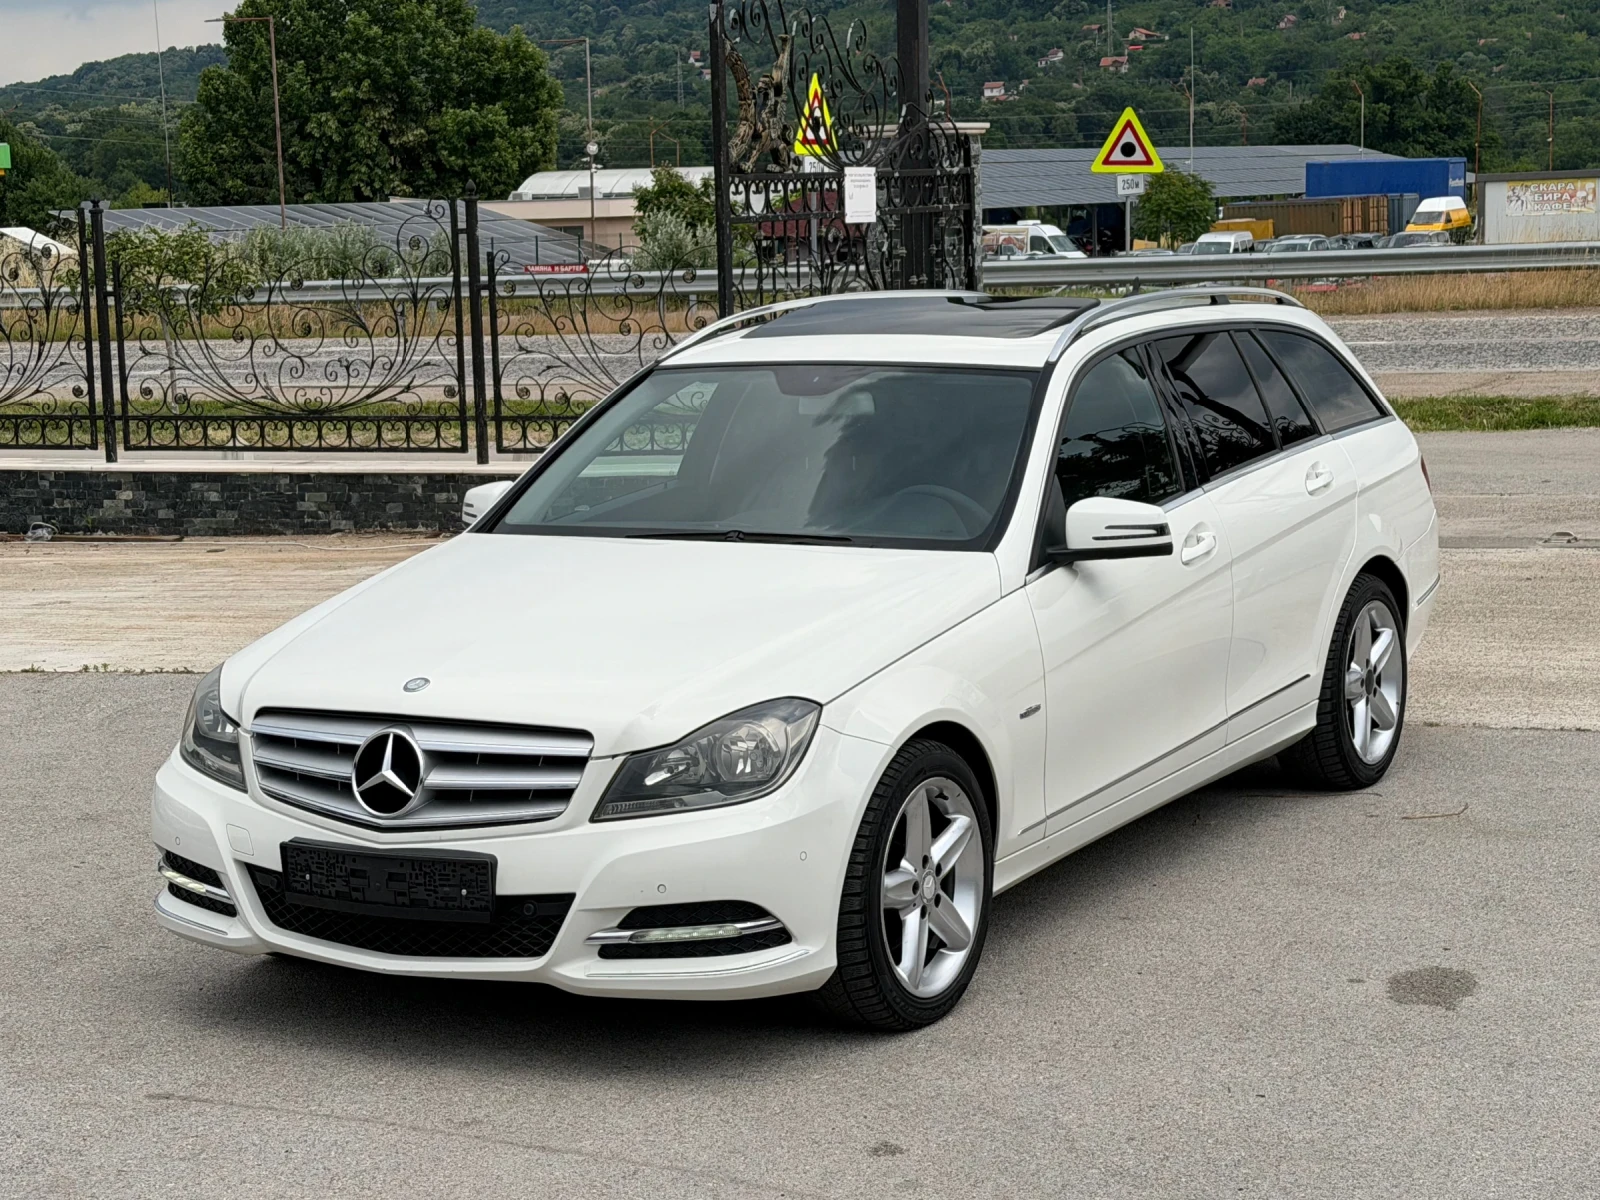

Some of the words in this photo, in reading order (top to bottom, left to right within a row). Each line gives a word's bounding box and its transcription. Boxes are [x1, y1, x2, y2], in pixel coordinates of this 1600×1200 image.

[1530, 183, 1575, 192] СКАРА
[1534, 193, 1571, 201] БИРА
[1534, 202, 1571, 211] КАФЕ
